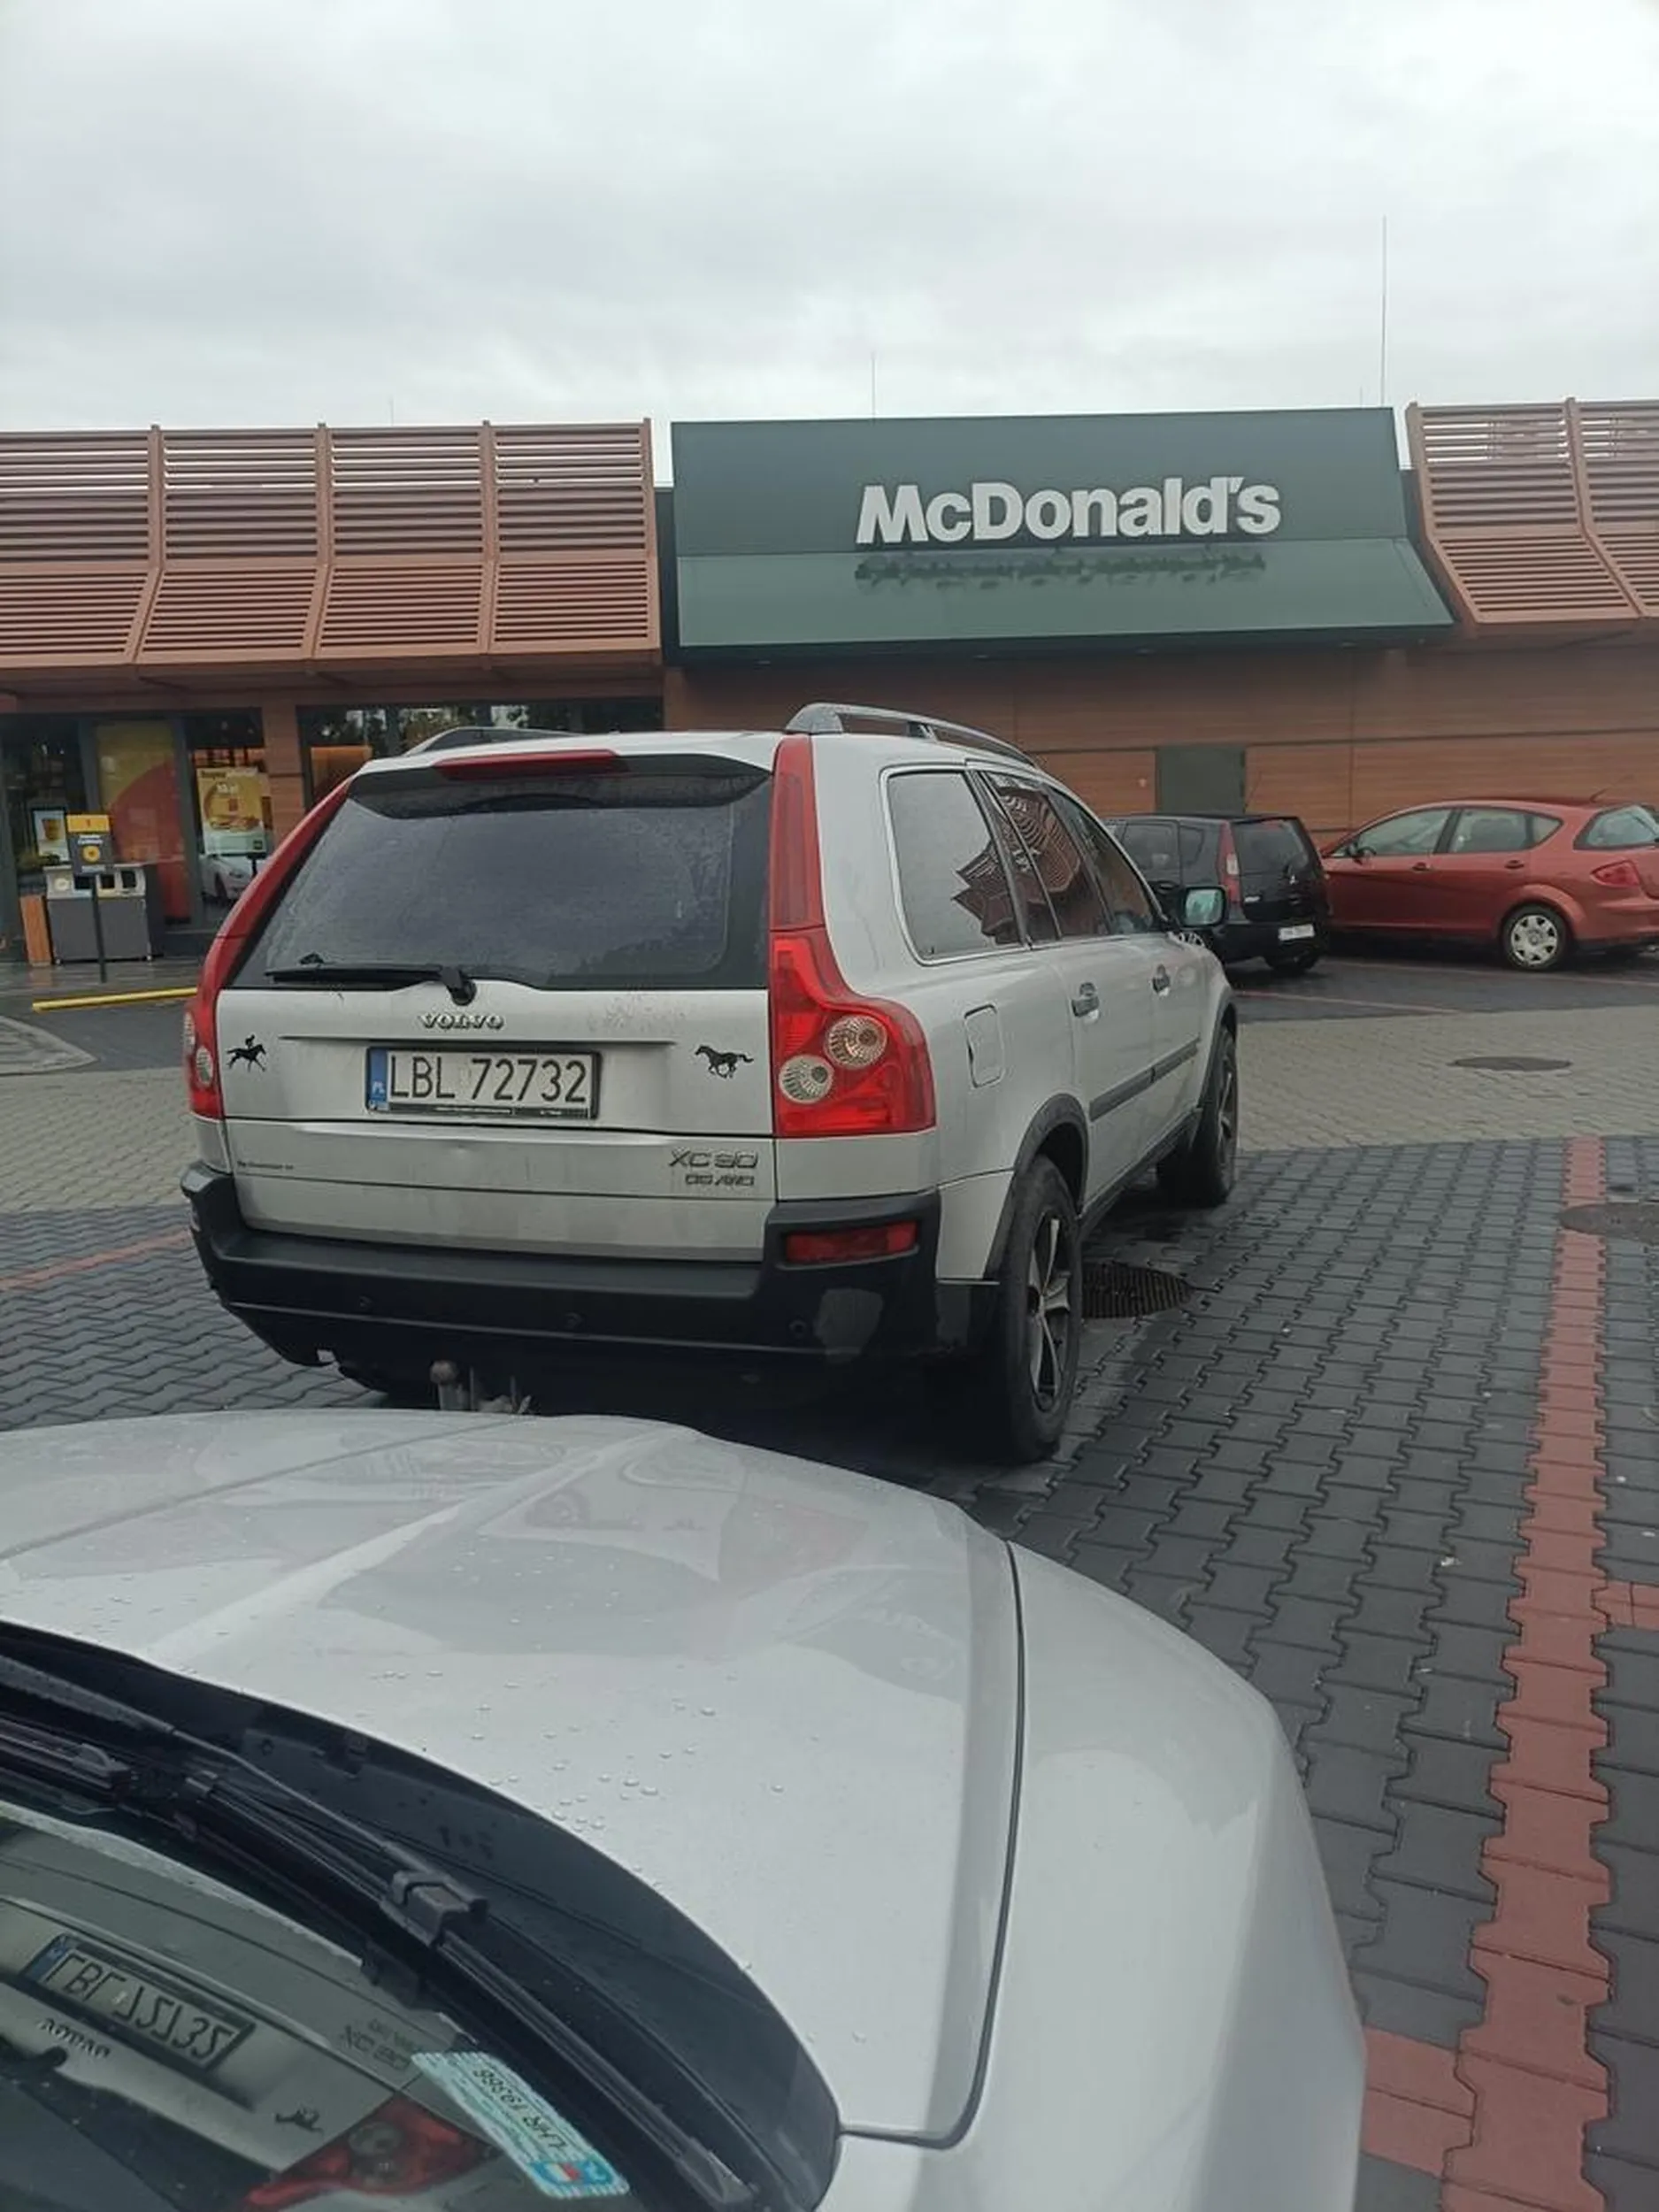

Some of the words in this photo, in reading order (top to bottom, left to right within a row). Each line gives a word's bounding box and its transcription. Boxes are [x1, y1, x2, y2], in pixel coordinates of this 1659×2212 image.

[856, 476, 1281, 544] McDonald's
[419, 1013, 505, 1031] VOLVO
[390, 1055, 456, 1099] LBL
[470, 1057, 587, 1103] 72732
